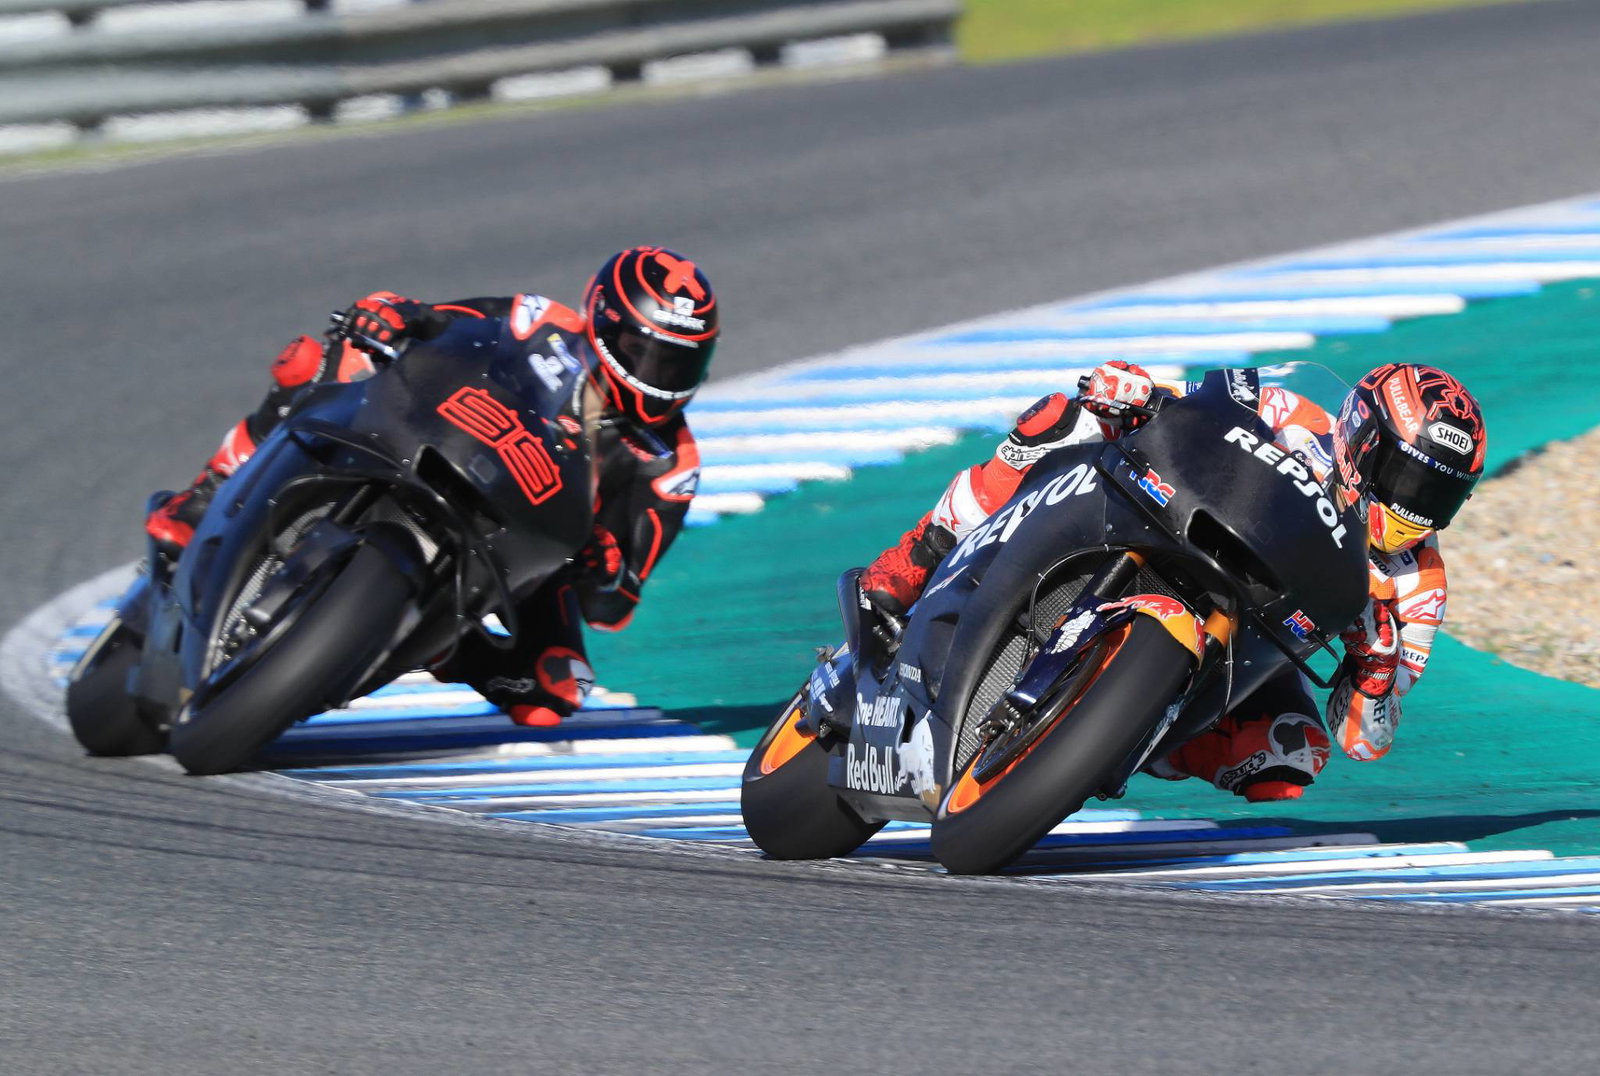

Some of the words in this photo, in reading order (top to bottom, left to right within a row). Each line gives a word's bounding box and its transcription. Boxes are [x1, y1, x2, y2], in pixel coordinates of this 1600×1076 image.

[1388, 377, 1419, 433] PULL&BEAR
[1400, 441, 1429, 464] GIVES
[1434, 461, 1454, 475] YOU
[1437, 427, 1469, 451] SHOEI
[1223, 425, 1348, 549] REPSOL
[1391, 502, 1433, 526] PULL&BEAR
[847, 742, 870, 791] Red
[869, 746, 895, 795] Bull
